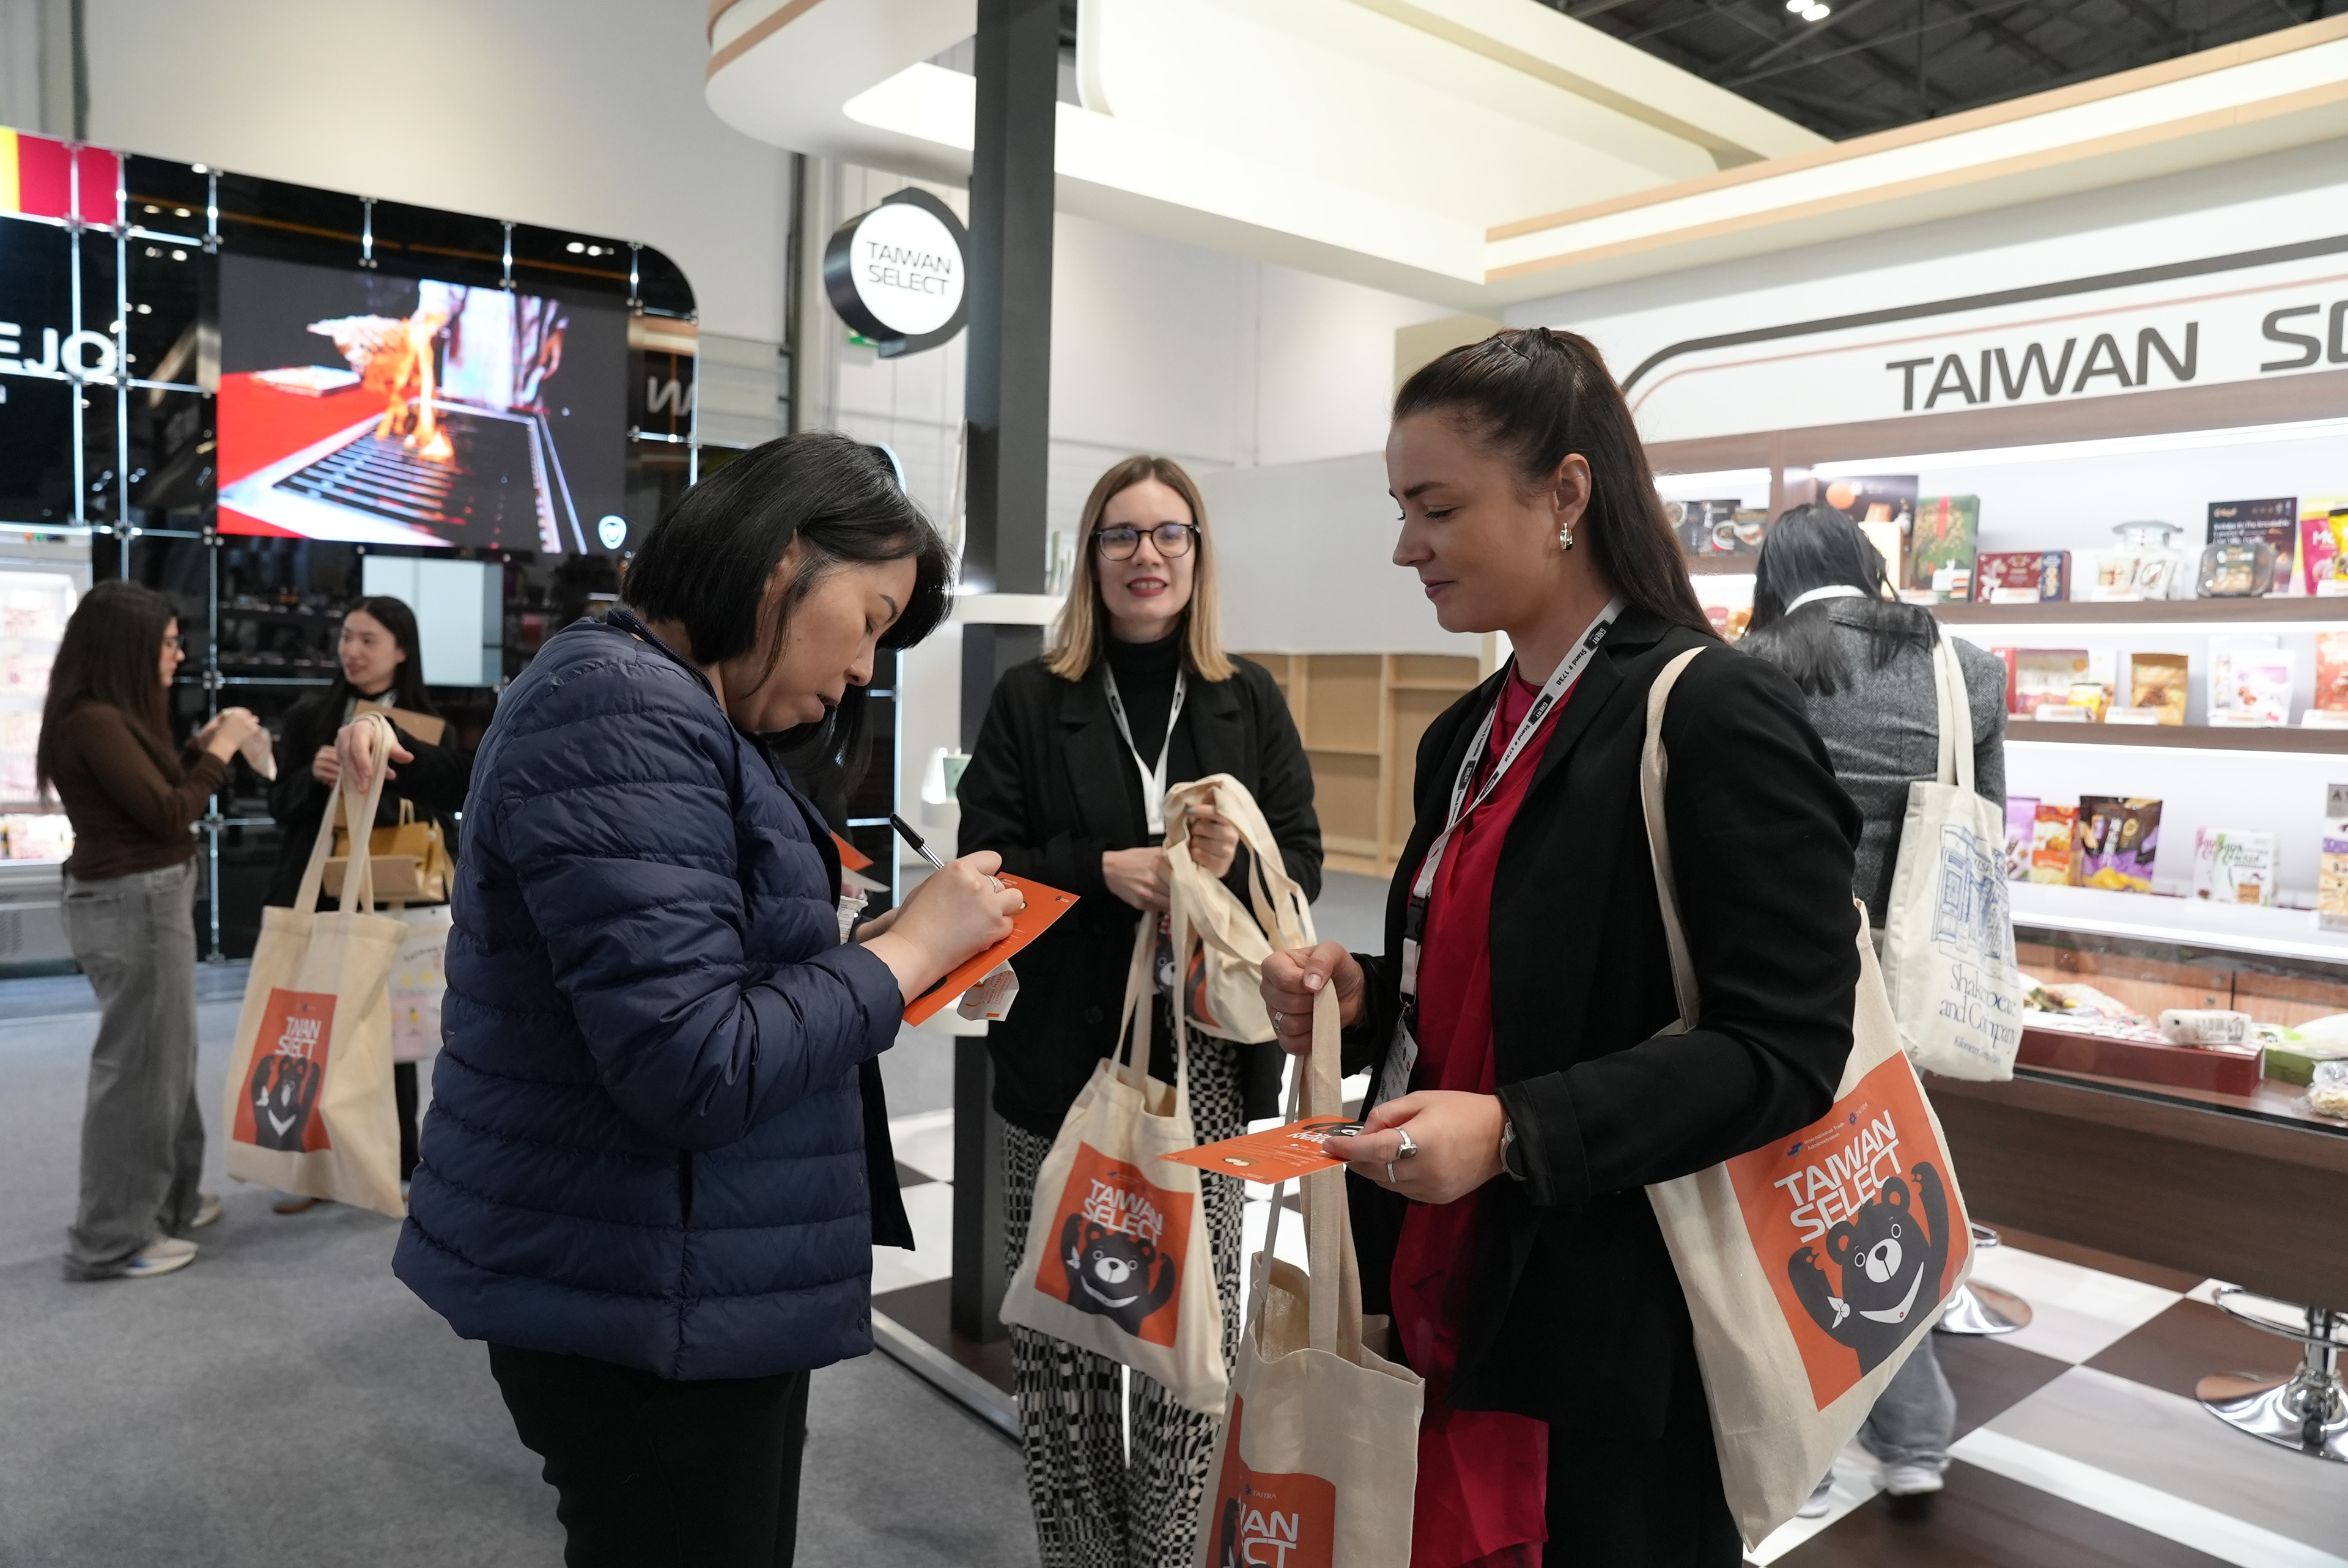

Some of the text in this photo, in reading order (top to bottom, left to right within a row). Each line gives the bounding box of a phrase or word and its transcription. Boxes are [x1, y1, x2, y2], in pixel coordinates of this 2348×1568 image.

[866, 240, 951, 275] TAIWAN
[868, 264, 950, 296] SELECT
[1886, 322, 2199, 412] TAIWAN
[1571, 649, 1587, 666] Stand
[1556, 670, 1570, 686] 1738
[1517, 724, 1530, 741] Stand
[1504, 747, 1515, 762] 1738
[1940, 995, 1966, 1024] and
[1804, 1122, 1845, 1145] International Trade
[1807, 1132, 1840, 1151] Administration
[1774, 1110, 1896, 1207] TAIWAN
[1790, 1138, 1902, 1243] SELECT
[1081, 1197, 1162, 1247] SELECT
[1253, 1490, 1277, 1500] TAITRA
